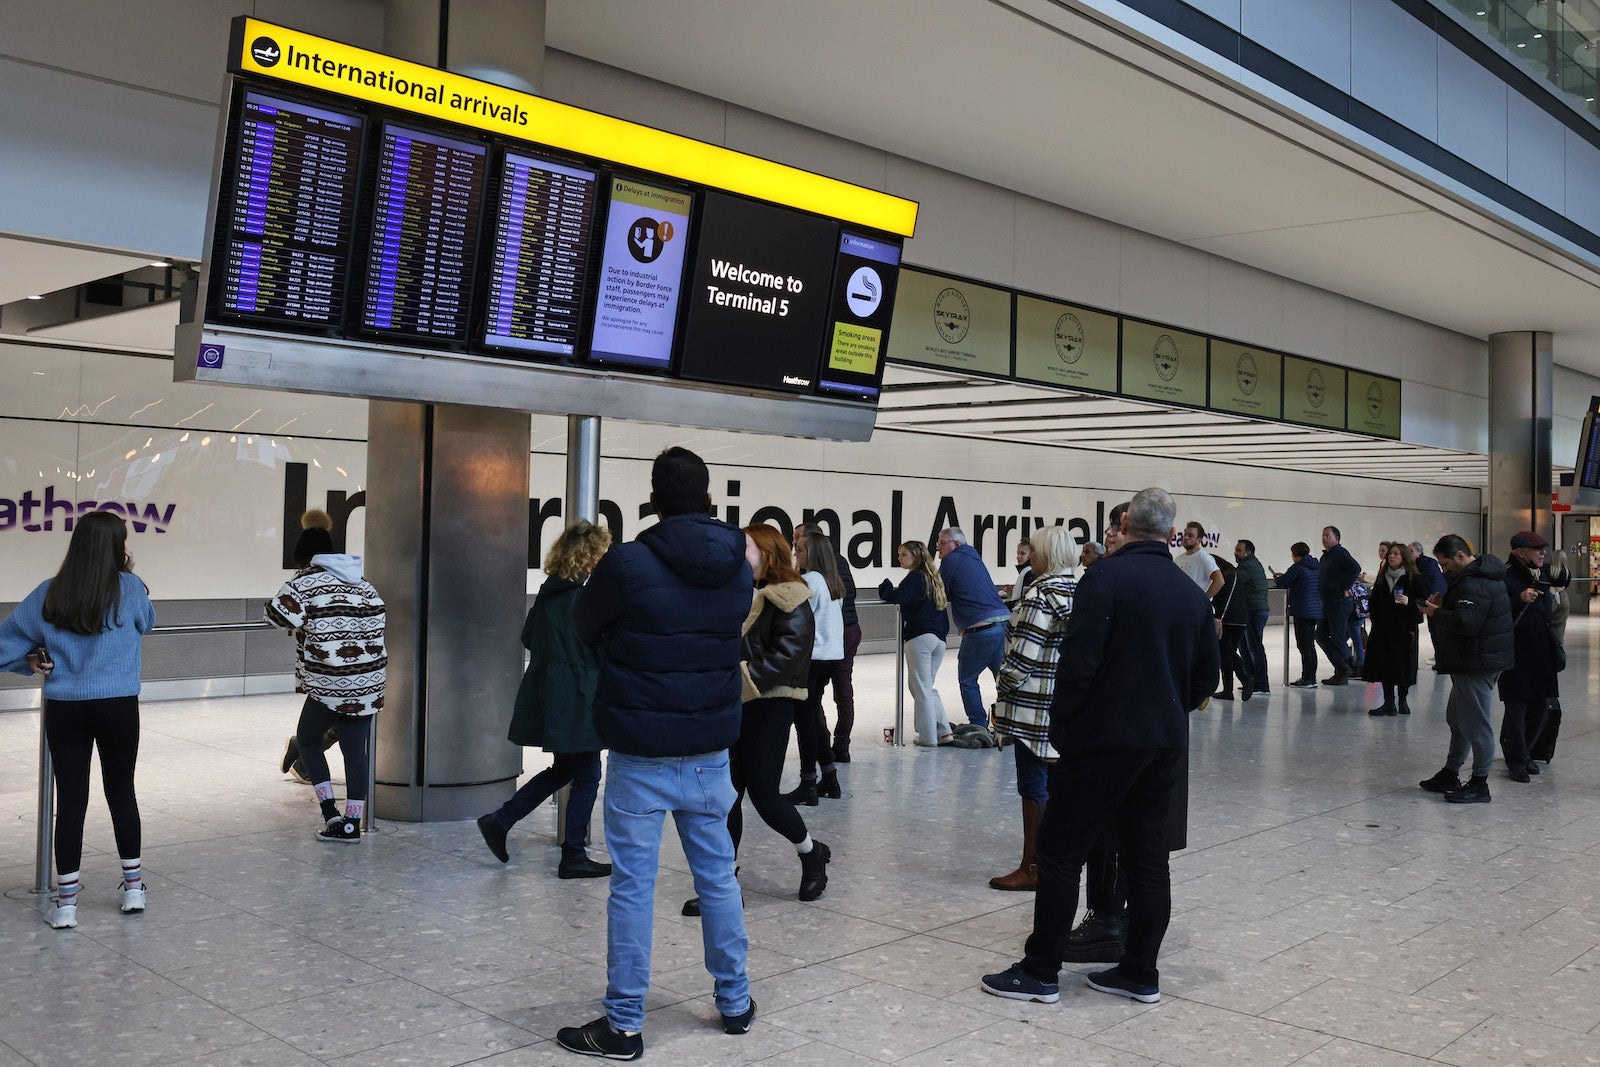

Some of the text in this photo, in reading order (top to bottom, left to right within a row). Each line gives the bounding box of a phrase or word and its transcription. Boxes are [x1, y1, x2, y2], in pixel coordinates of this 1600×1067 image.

[287, 45, 529, 126] International arrivals
[624, 186, 642, 196] Delays
[651, 192, 684, 204] immigration
[608, 266, 620, 274] Due
[630, 270, 658, 281] industrial
[711, 258, 803, 294] Welcome to
[627, 278, 634, 287] by
[636, 280, 656, 290] Border
[657, 284, 672, 292] Force
[606, 284, 669, 302] staff, passengers may
[605, 294, 637, 304] experience
[638, 298, 657, 309] delays
[707, 285, 790, 317] Terminal 5
[604, 302, 642, 314] immigration.
[610, 316, 631, 324] apologise
[936, 310, 967, 321] SKYTRAX
[601, 323, 632, 331] inconvenience
[839, 329, 861, 341] Smoking
[1056, 333, 1082, 342] SKYTRAX
[858, 344, 876, 352] smoking
[835, 356, 852, 365] building
[783, 375, 810, 386] Heathrow
